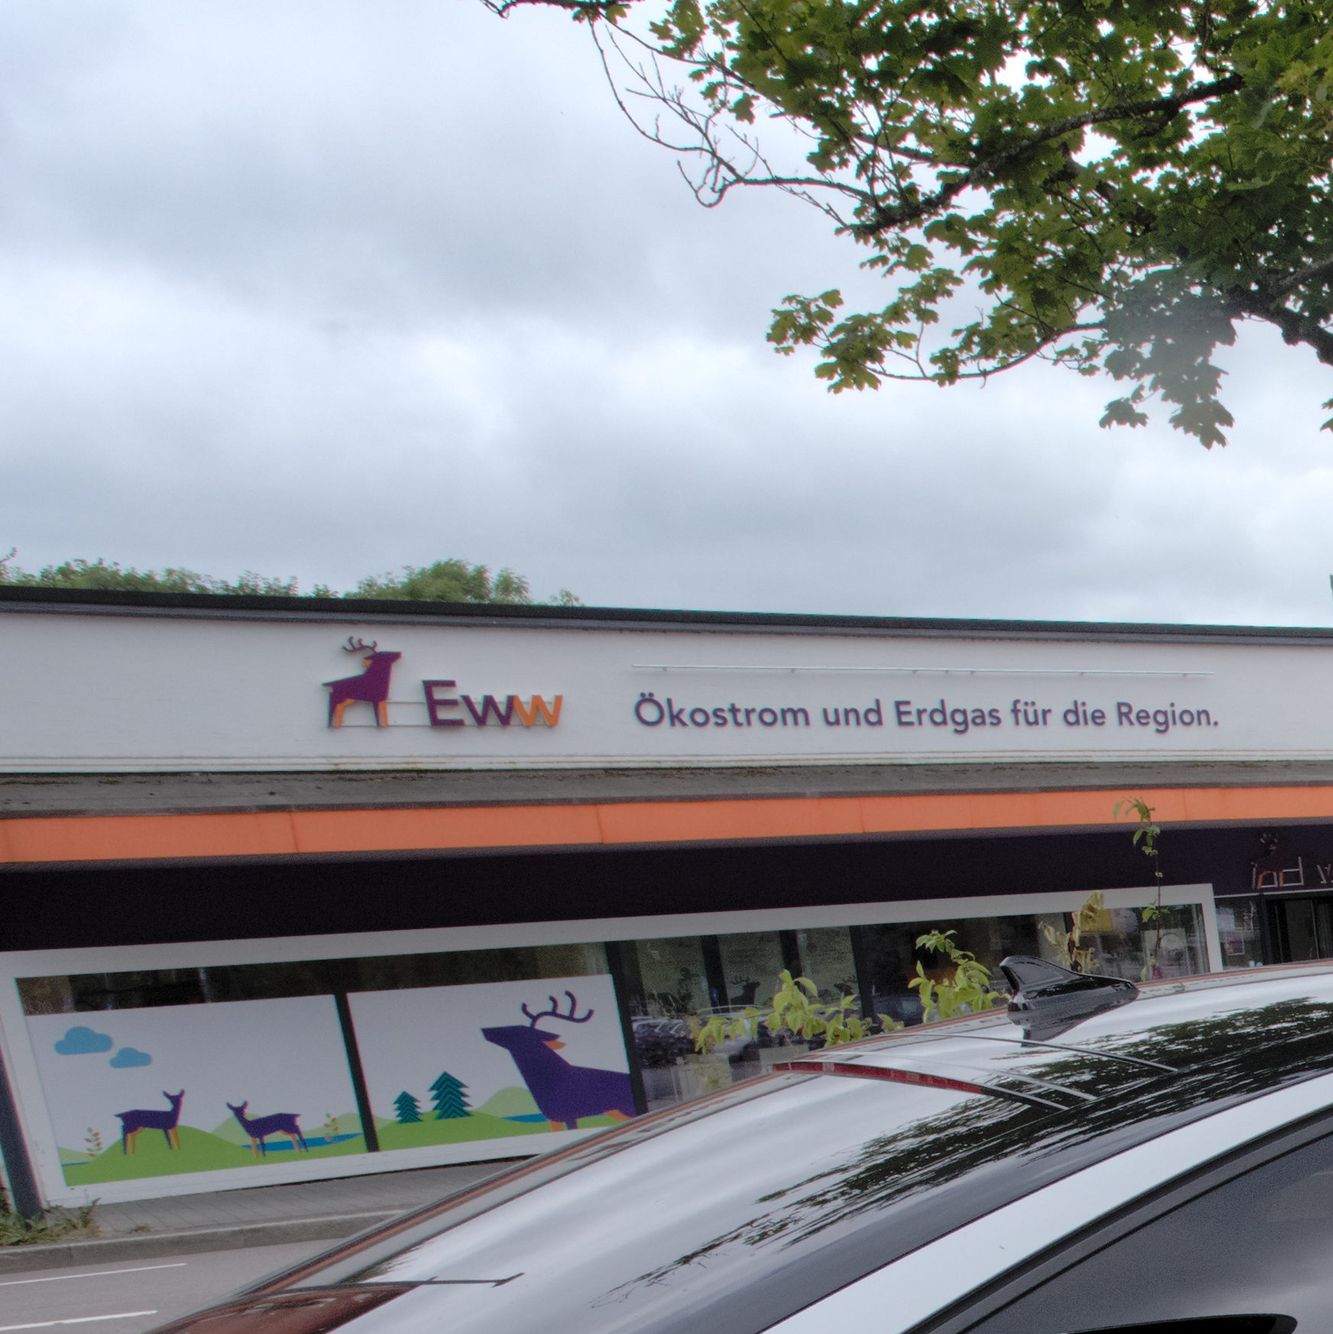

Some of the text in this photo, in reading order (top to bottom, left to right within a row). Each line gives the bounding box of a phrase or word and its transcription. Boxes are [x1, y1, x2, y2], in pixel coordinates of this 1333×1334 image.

[421, 679, 564, 728] Eww
[634, 692, 1220, 735] Ökostrom und Erdgas für die Region.
